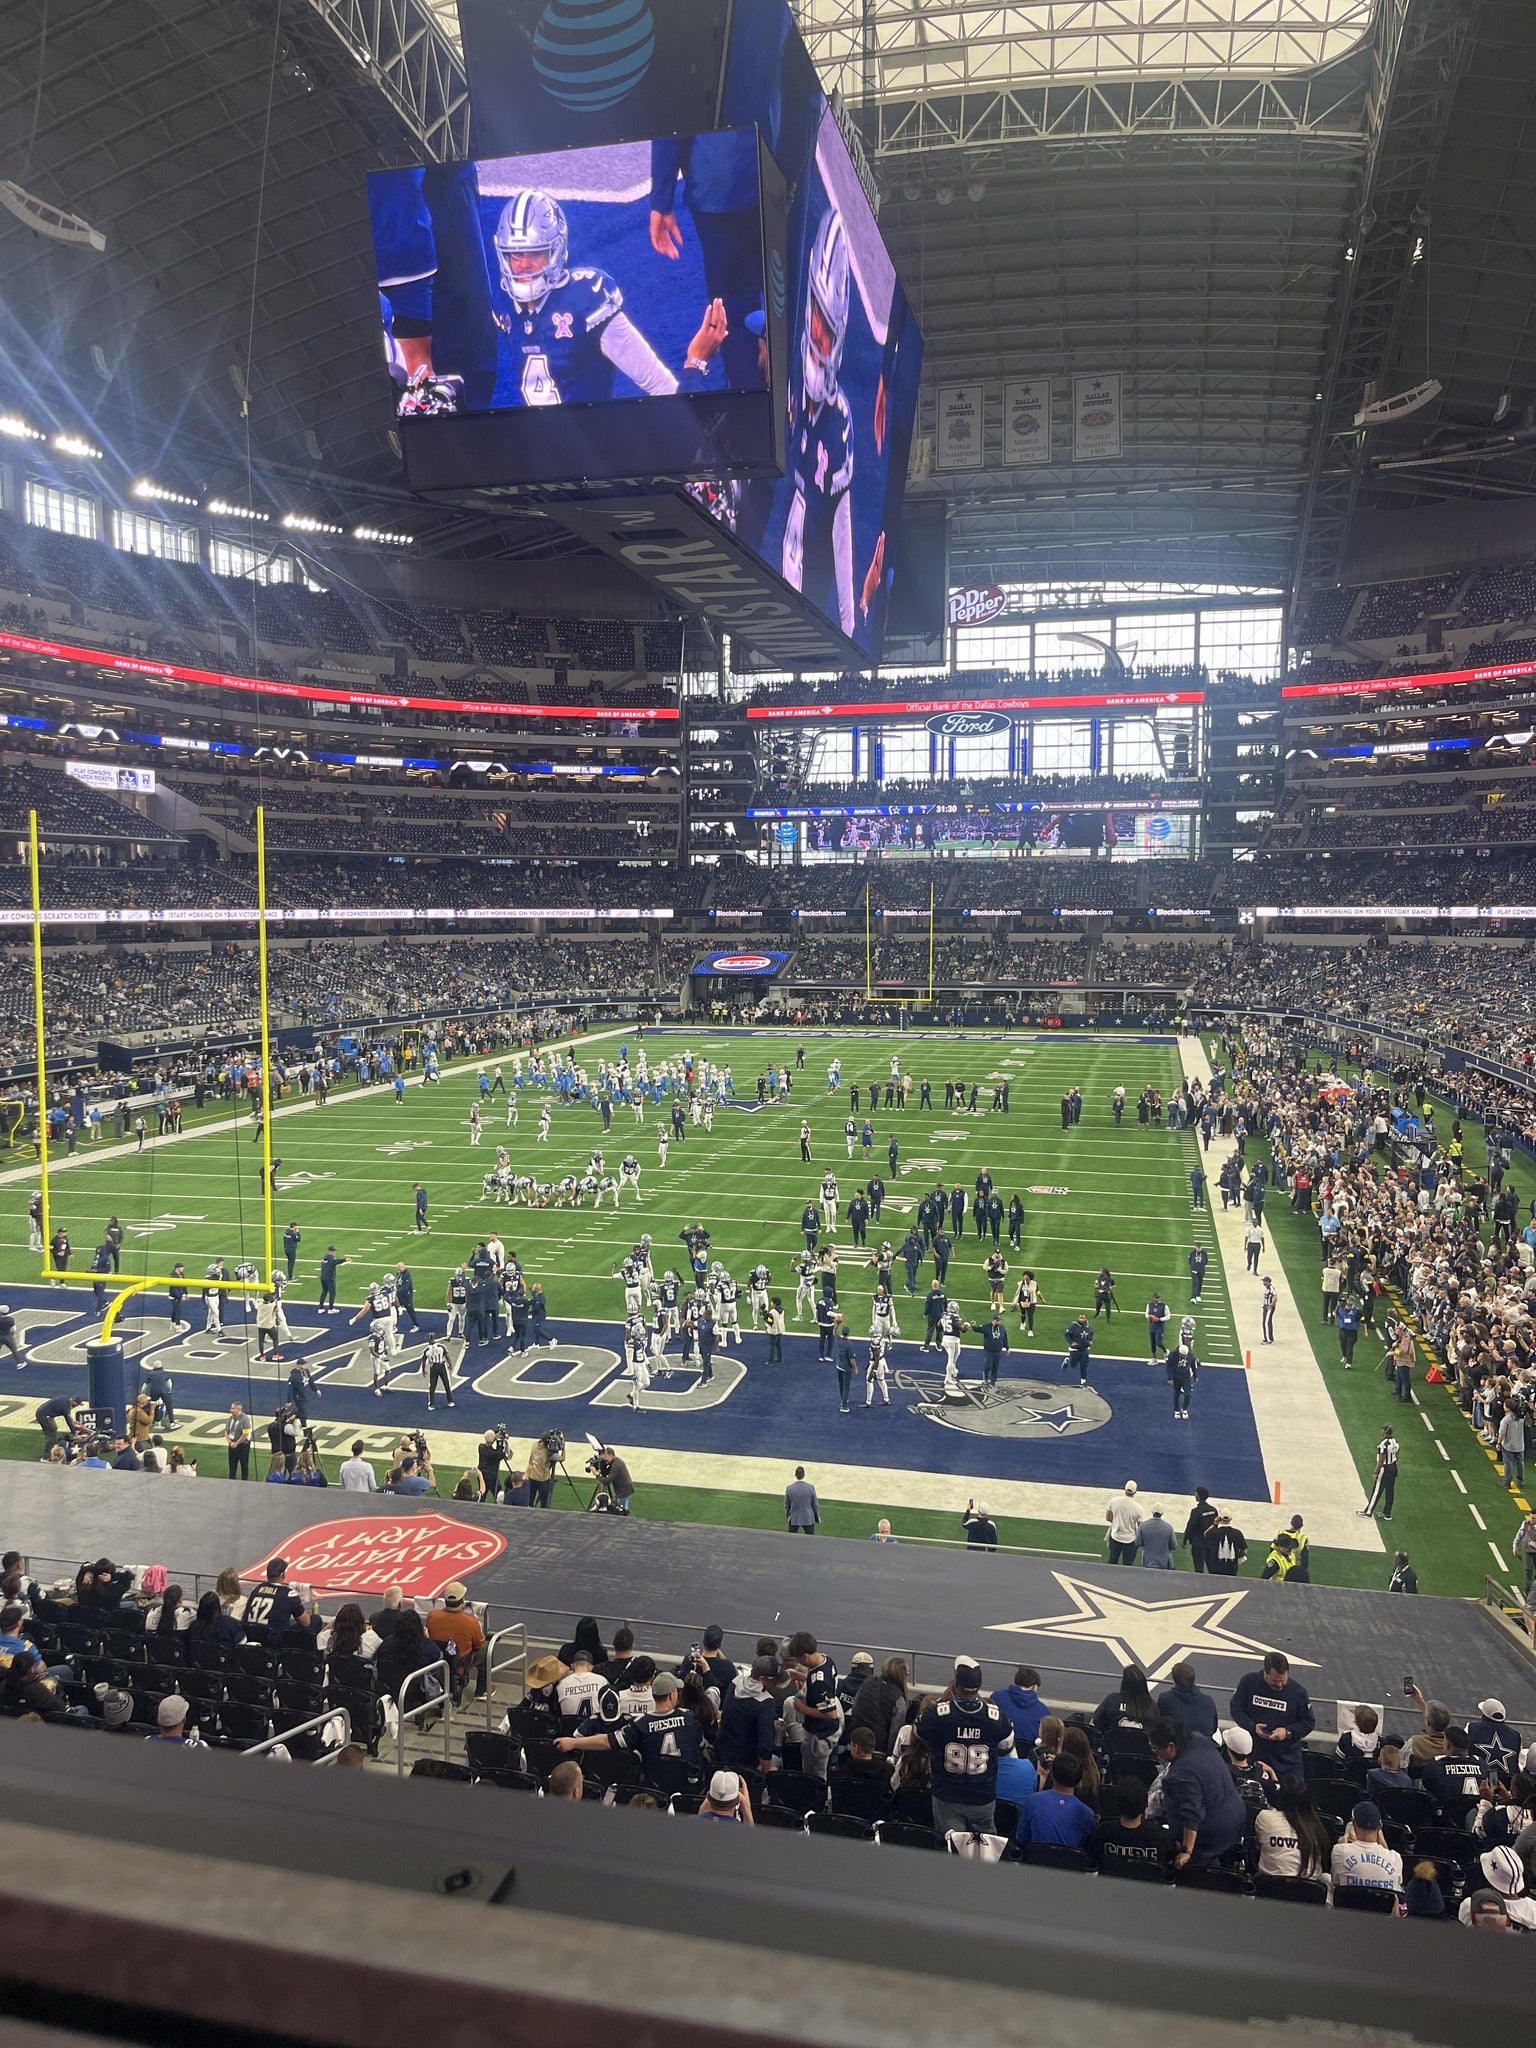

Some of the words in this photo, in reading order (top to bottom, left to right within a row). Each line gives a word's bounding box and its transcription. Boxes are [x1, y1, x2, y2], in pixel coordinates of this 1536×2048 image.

[521, 355, 562, 406] 4
[1086, 392, 1110, 400] DALLAS
[1013, 404, 1042, 412] COWBOYS
[1082, 399, 1113, 408] COWBOYS
[946, 410, 975, 418] COWBOYS
[1014, 438, 1039, 446] WORLD
[1085, 433, 1111, 441] WORLD
[1007, 445, 1047, 454] CHAMPIONS
[1077, 440, 1118, 450] CHAMPIONS
[940, 450, 980, 459] CHAMPIONS
[619, 539, 844, 657] WINSTAR
[966, 590, 989, 608] Dr
[949, 595, 1003, 623] Pepper
[21, 640, 38, 651] Dallas
[115, 660, 131, 669] BANK
[140, 664, 164, 674] AMERICA
[1502, 667, 1532, 676] AMERICA
[223, 678, 240, 687] Official
[240, 680, 250, 688] Bank
[265, 683, 278, 692] Dallas
[279, 685, 299, 696] Cowboys
[1339, 684, 1351, 692] Bank
[1358, 682, 1370, 690] the
[1371, 681, 1387, 690] Dallas
[1388, 679, 1412, 689] Cowboys
[350, 696, 365, 704] BANK
[906, 703, 931, 712] Official
[934, 702, 951, 712] Bank
[952, 701, 959, 710] of
[960, 701, 973, 710] the
[975, 700, 996, 709] Dallas
[998, 700, 1029, 710] Cowboys
[1134, 696, 1165, 704] AMERICA
[462, 704, 478, 712] Official
[479, 705, 490, 713] Bank
[508, 706, 522, 714] Dallas
[523, 707, 544, 715] Cowboys
[942, 714, 995, 733] Ford
[1390, 743, 1429, 753] SUPERCROSS
[88, 769, 111, 777] COWBOYS
[936, 805, 958, 813] 31:30
[304, 1526, 452, 1552] ARMY
[326, 1566, 427, 1588] THE
[248, 1596, 275, 1626] 32
[565, 1683, 600, 1697] PRESCOTT
[576, 1696, 595, 1716] 4
[629, 1704, 648, 1714] LAMB
[1255, 1697, 1285, 1710] COWBOYS
[649, 1716, 686, 1733] PRESCOTT
[957, 1727, 981, 1739] LAMB
[660, 1732, 682, 1757] 4
[944, 1742, 990, 1776] 88
[1446, 1764, 1482, 1776] PRESCOTT
[1343, 1856, 1358, 1871] LOS
[1361, 1853, 1396, 1876] ANGELES
[1347, 1876, 1394, 1890] CHARGERS
